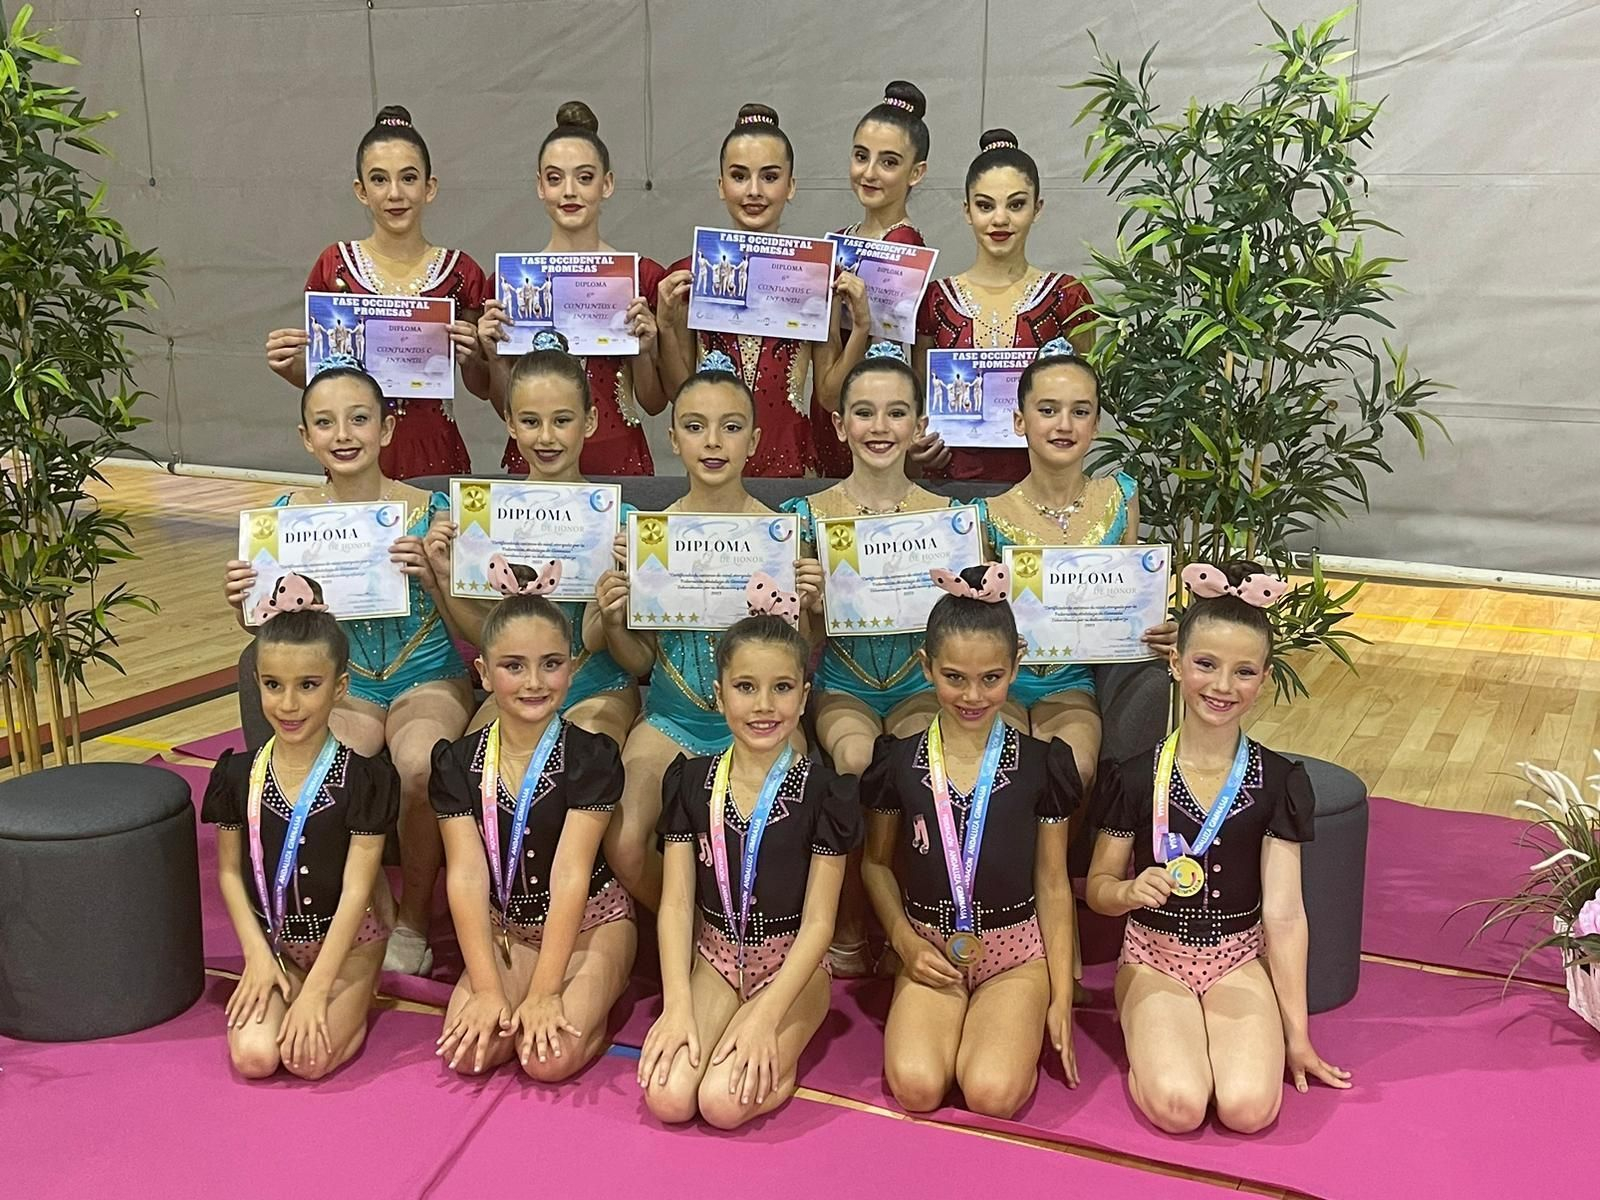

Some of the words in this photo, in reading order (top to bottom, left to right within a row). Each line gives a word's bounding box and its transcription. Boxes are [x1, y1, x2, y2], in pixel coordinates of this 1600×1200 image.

[720, 233, 746, 243] FASE
[748, 235, 812, 249] OCCIDENTAL
[843, 239, 863, 248] FASE
[865, 242, 917, 256] OCCIDENTAL
[740, 243, 795, 256] PROMESAS
[856, 248, 901, 261] PROMESAS
[332, 298, 360, 306] FASE
[362, 298, 430, 309] OCCIDENTAL
[354, 307, 412, 317] PROMESAS
[981, 352, 1036, 360] OCCIDENT
[498, 508, 571, 521] DIPLOMA
[285, 528, 358, 543] DIPLOMA
[675, 540, 750, 552] DIPLOMA
[864, 538, 937, 555] DIPLOMA
[1050, 572, 1124, 584] DIPLOMA
[968, 821, 980, 854] ANDALUZA
[974, 785, 987, 819] GIMNASIA
[1209, 796, 1229, 828] GIMNASIA
[508, 822, 522, 855] ANDALUZA
[517, 788, 529, 820] GIMNASIA
[278, 850, 293, 884] ANDALUZA
[289, 815, 302, 849] GIMNASIA
[743, 855, 753, 889] ANDALUZA
[749, 818, 762, 853] GIMNASIA
[716, 847, 725, 881] FEDERACIÓN
[943, 814, 953, 850] FEDERACIÓN
[948, 850, 962, 885] ANDALUZA
[956, 885, 967, 919] GIMNASIA
